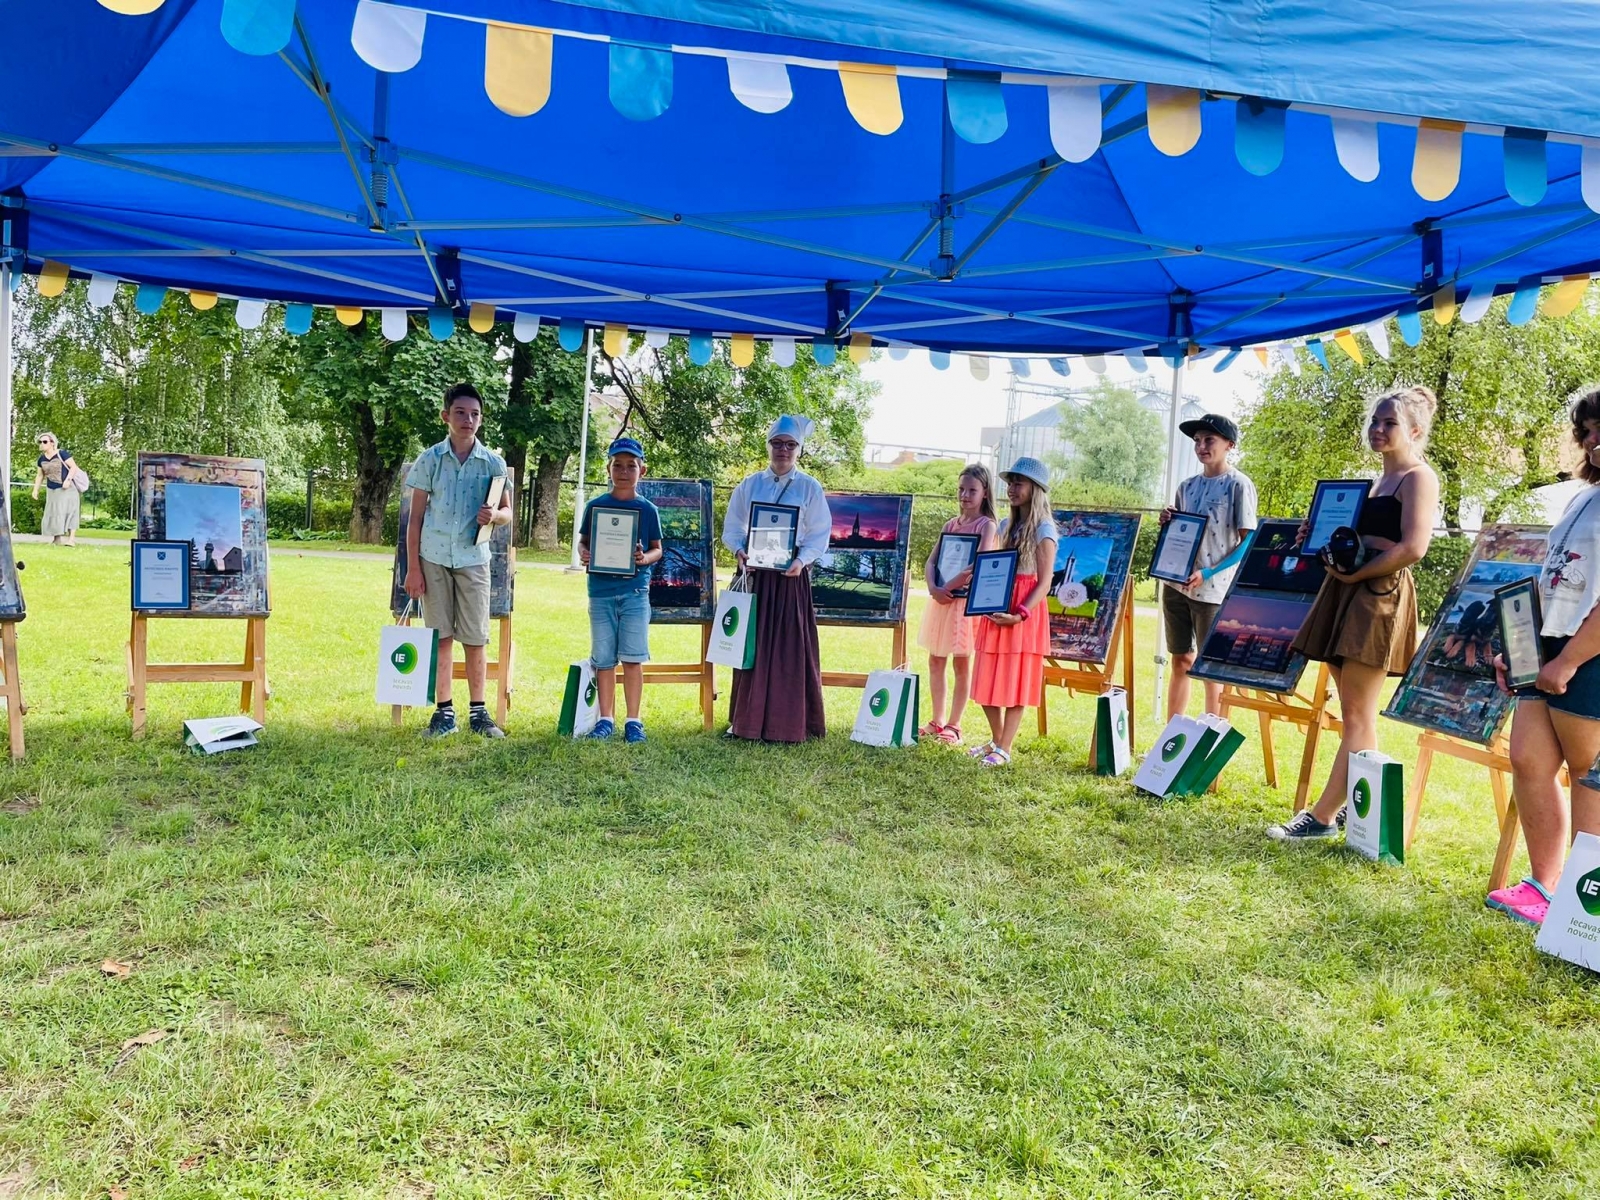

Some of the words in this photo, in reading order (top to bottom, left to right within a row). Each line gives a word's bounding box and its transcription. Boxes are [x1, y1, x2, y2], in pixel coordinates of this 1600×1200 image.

[724, 616, 732, 626] IE
[395, 653, 406, 663] IE
[871, 697, 881, 707] IE
[1164, 741, 1176, 752] IE
[1354, 789, 1363, 803] IE
[1582, 878, 1600, 896] IE
[1570, 917, 1600, 934] Iecavas
[1567, 926, 1598, 942] novads
